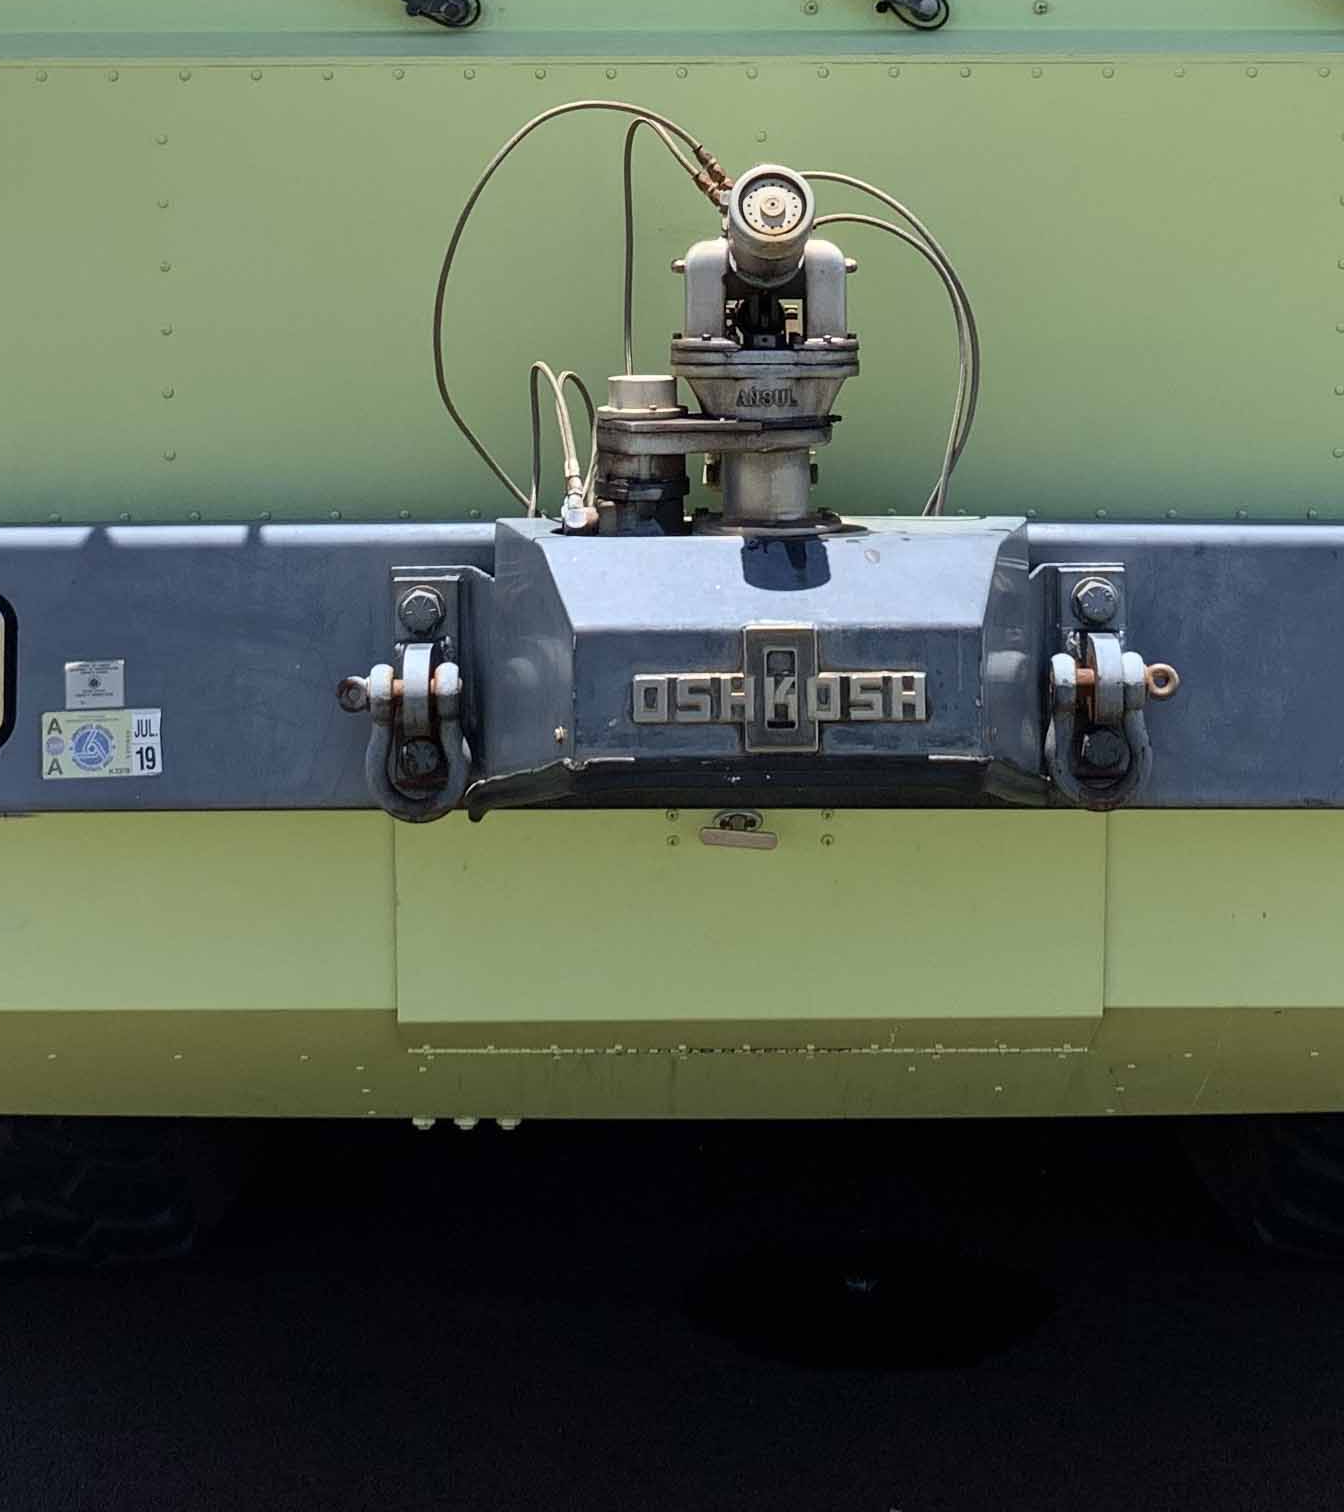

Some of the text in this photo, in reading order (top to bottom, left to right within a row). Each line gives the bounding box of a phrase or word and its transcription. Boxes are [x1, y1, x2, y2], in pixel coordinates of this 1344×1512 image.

[736, 387, 799, 407] ANSUL
[633, 672, 926, 723] OSHKOSH
[47, 718, 62, 735] A
[47, 758, 63, 775] A
[136, 746, 156, 771] 19
